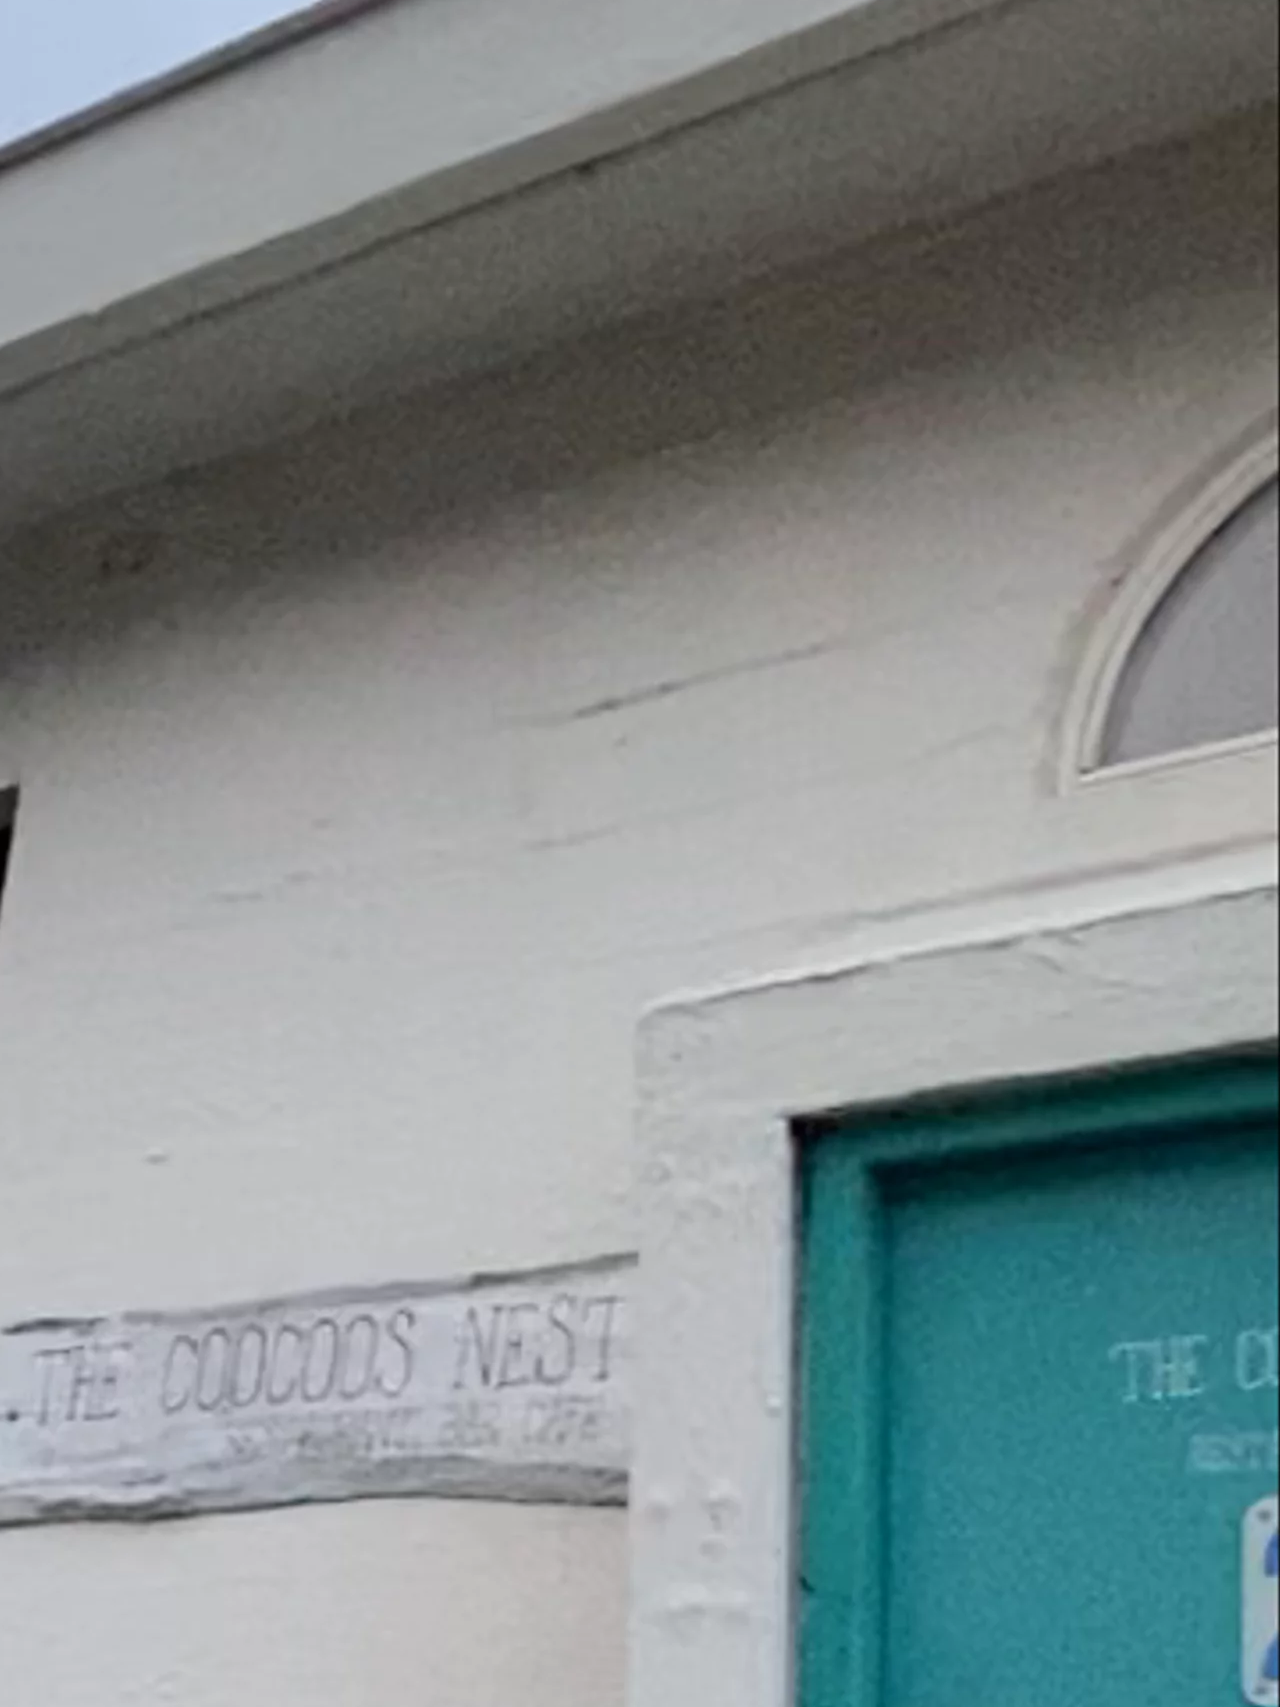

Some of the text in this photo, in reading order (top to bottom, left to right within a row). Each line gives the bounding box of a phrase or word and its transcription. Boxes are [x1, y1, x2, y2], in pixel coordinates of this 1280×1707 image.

[34, 1292, 626, 1426] THE COOCOOS NEST
[1107, 1334, 1208, 1402] THE
